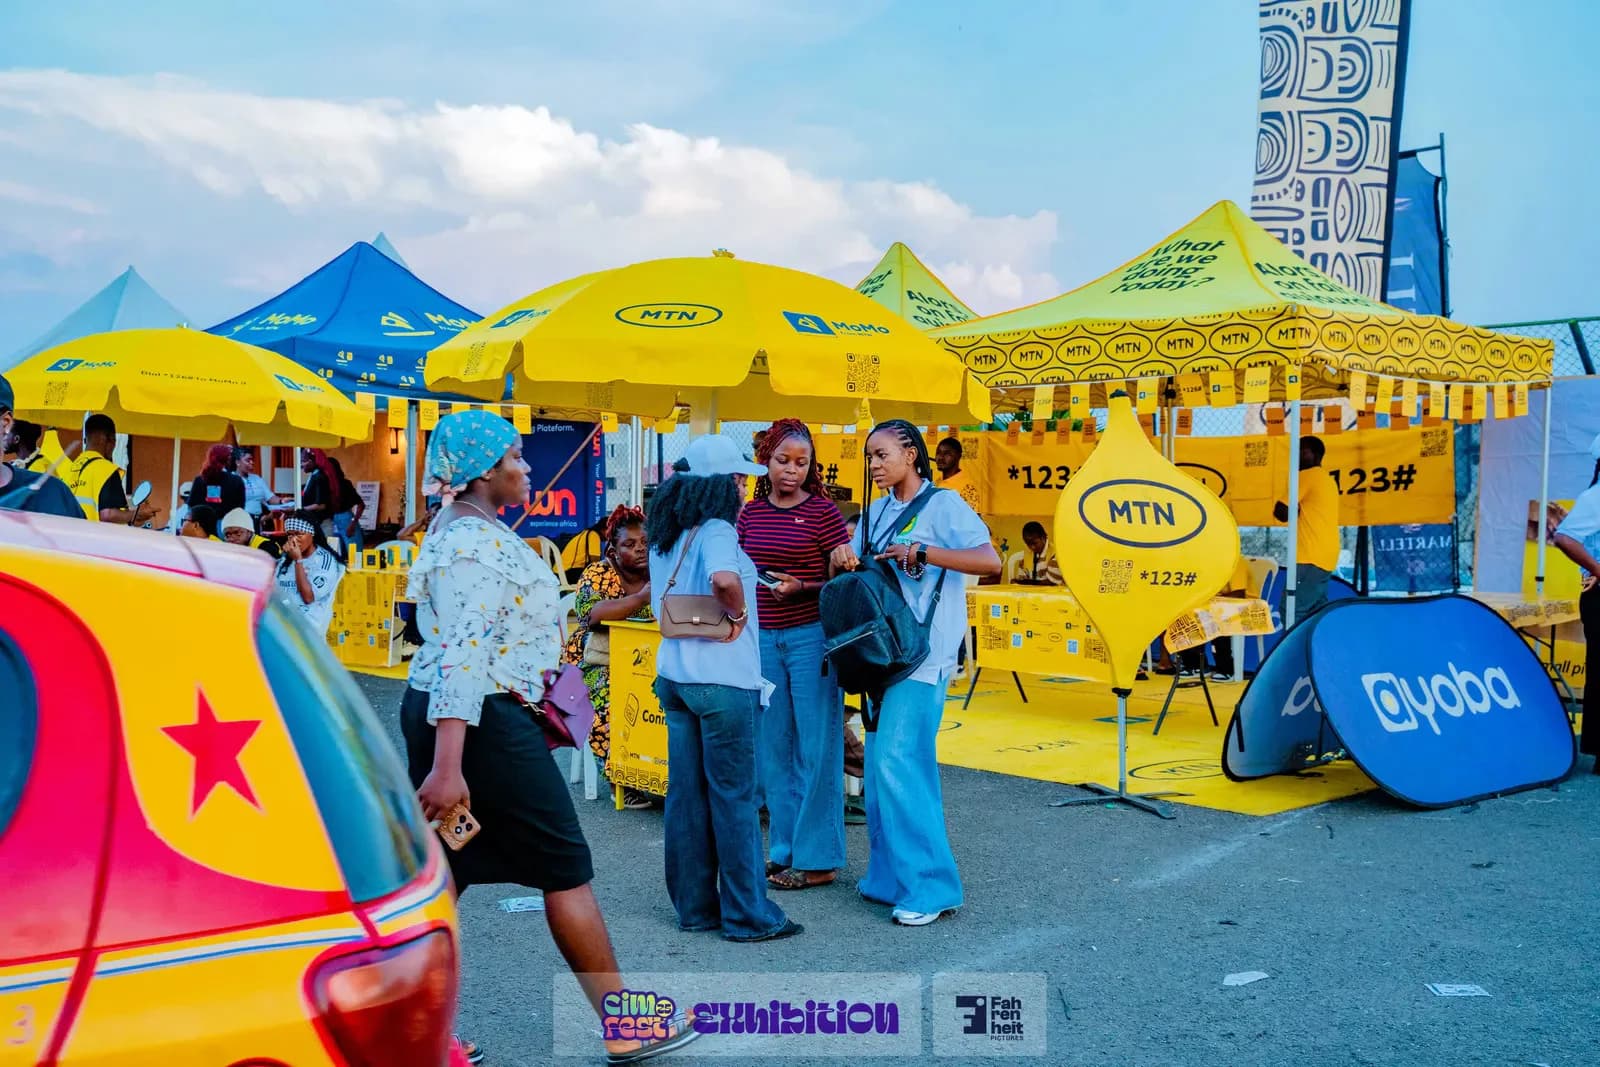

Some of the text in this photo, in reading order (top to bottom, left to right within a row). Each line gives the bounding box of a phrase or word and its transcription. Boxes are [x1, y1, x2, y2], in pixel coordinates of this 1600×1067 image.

[1151, 239, 1226, 257] What
[1126, 254, 1218, 272] are we
[1122, 264, 1205, 281] doing
[1110, 277, 1215, 293] today?
[640, 310, 698, 321] MTN
[831, 321, 890, 334] MoMo
[1221, 332, 1250, 345] MTN
[1328, 332, 1347, 343] MTN
[1364, 334, 1381, 345] MTN
[1397, 337, 1414, 348] MTN
[1115, 342, 1141, 353] MTN
[1167, 338, 1194, 350] MTN
[1430, 339, 1446, 350] MTN
[1461, 344, 1476, 355] MTN
[1019, 350, 1043, 362] MTN
[1066, 345, 1091, 357] MTN
[1490, 349, 1505, 360] MTN
[974, 354, 997, 365] MTN
[1518, 353, 1533, 363] MTN
[536, 424, 575, 433] Plateform.
[1007, 464, 1081, 490] 123
[1329, 464, 1417, 495] 123#
[1108, 499, 1176, 527] MTN
[560, 520, 578, 528] africa
